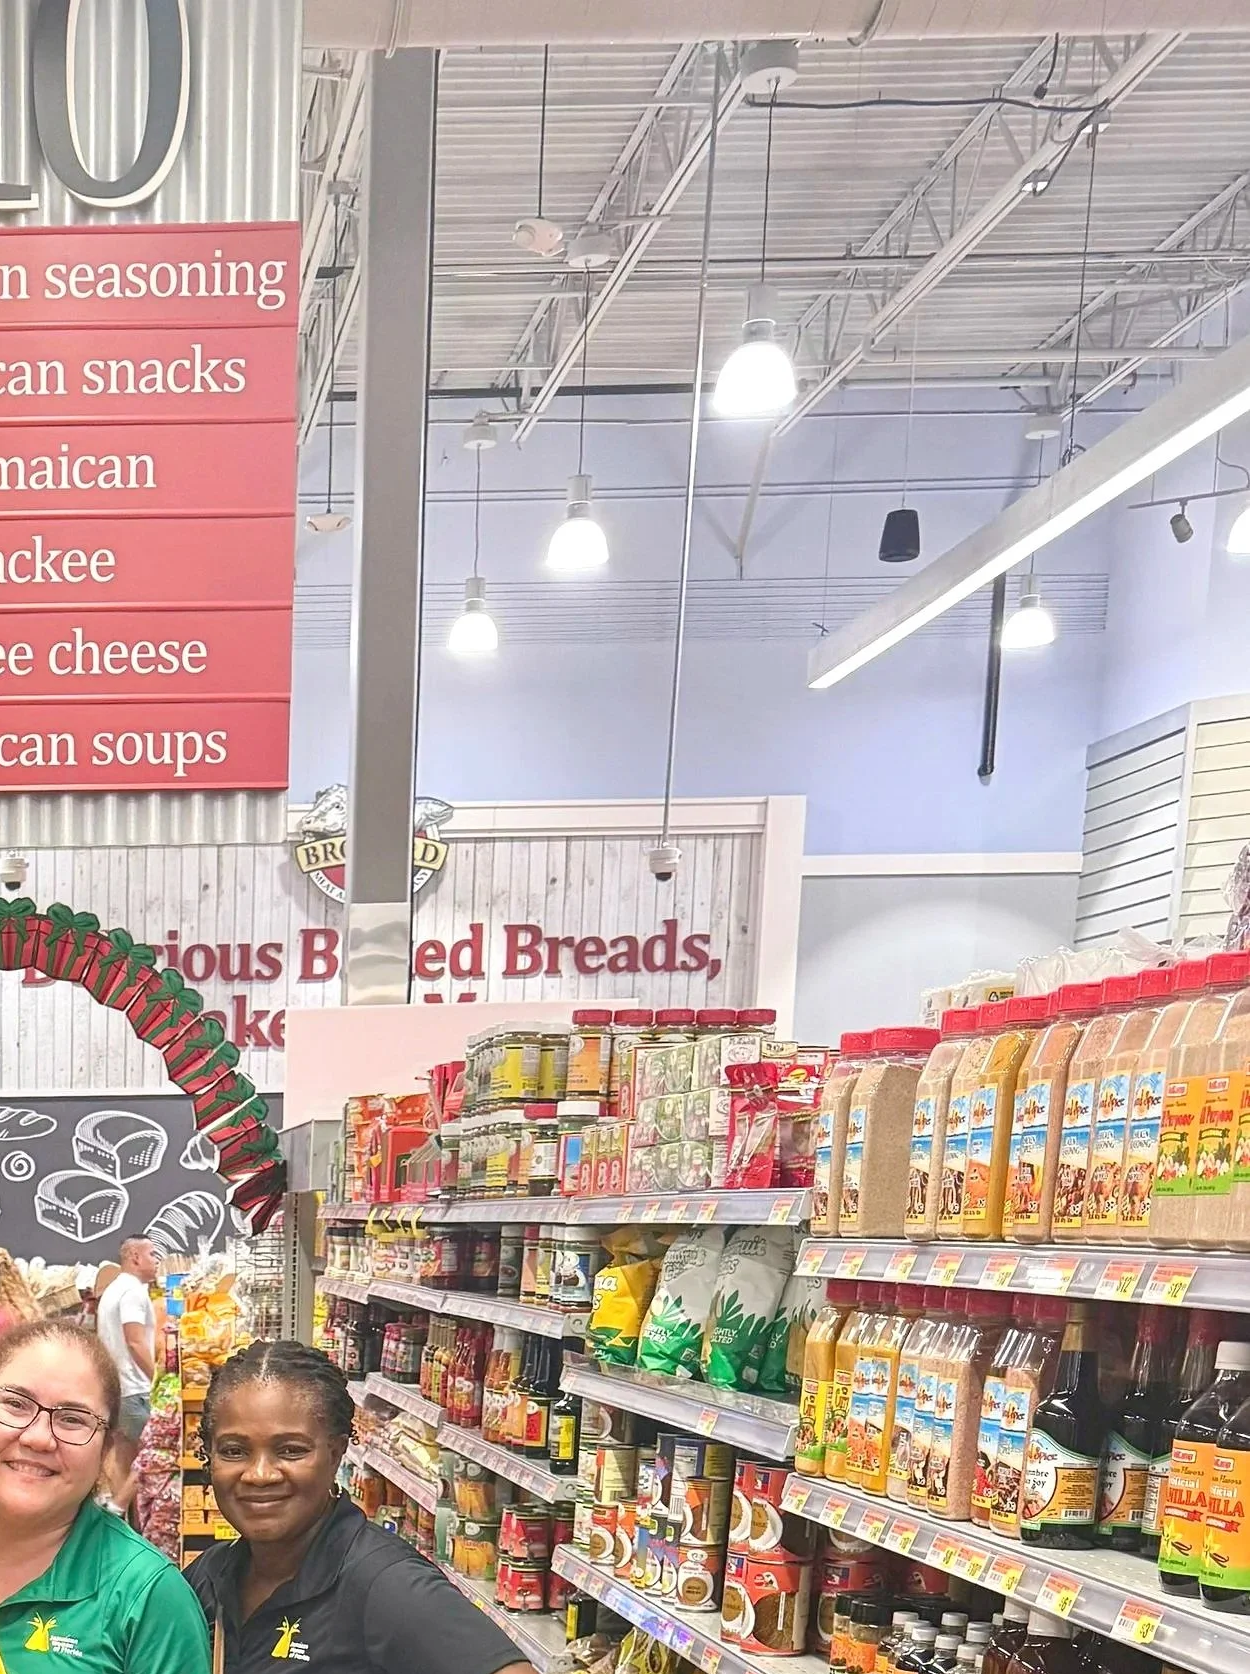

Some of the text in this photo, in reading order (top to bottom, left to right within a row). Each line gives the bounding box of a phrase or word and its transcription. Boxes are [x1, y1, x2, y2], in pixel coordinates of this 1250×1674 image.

[44, 249, 288, 311] seasoning
[81, 344, 247, 395] snacks
[48, 628, 208, 675] cheese
[91, 728, 228, 777] soups
[501, 919, 723, 983] Breads,
